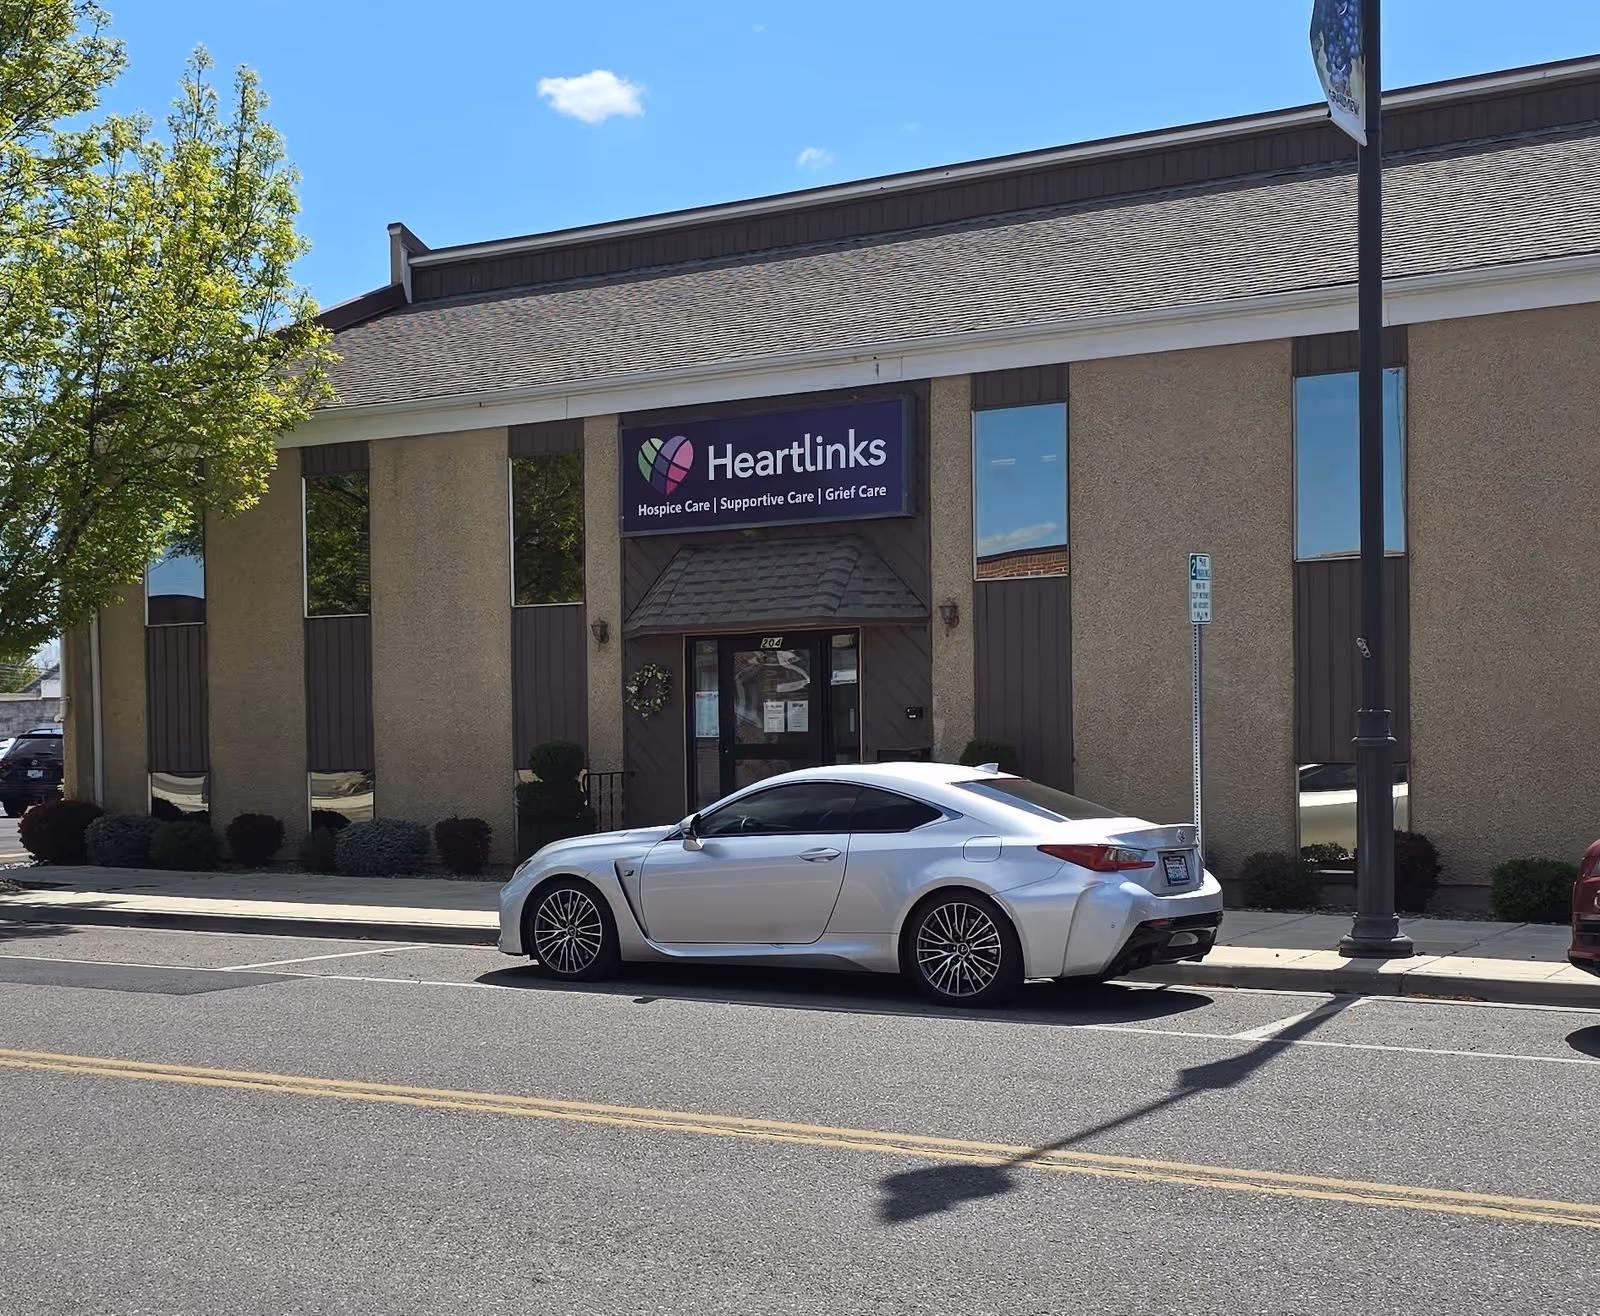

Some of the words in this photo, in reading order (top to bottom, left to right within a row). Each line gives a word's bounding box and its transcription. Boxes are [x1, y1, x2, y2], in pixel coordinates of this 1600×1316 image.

[708, 428, 887, 481] Heartlinks
[638, 502, 682, 518] Hospice
[685, 500, 710, 512] Care
[720, 492, 785, 512] Supportive
[787, 491, 815, 504] Care
[825, 485, 856, 501] Grief
[858, 485, 887, 498] Care
[1191, 559, 1196, 576] 2
[761, 638, 782, 648] 204
